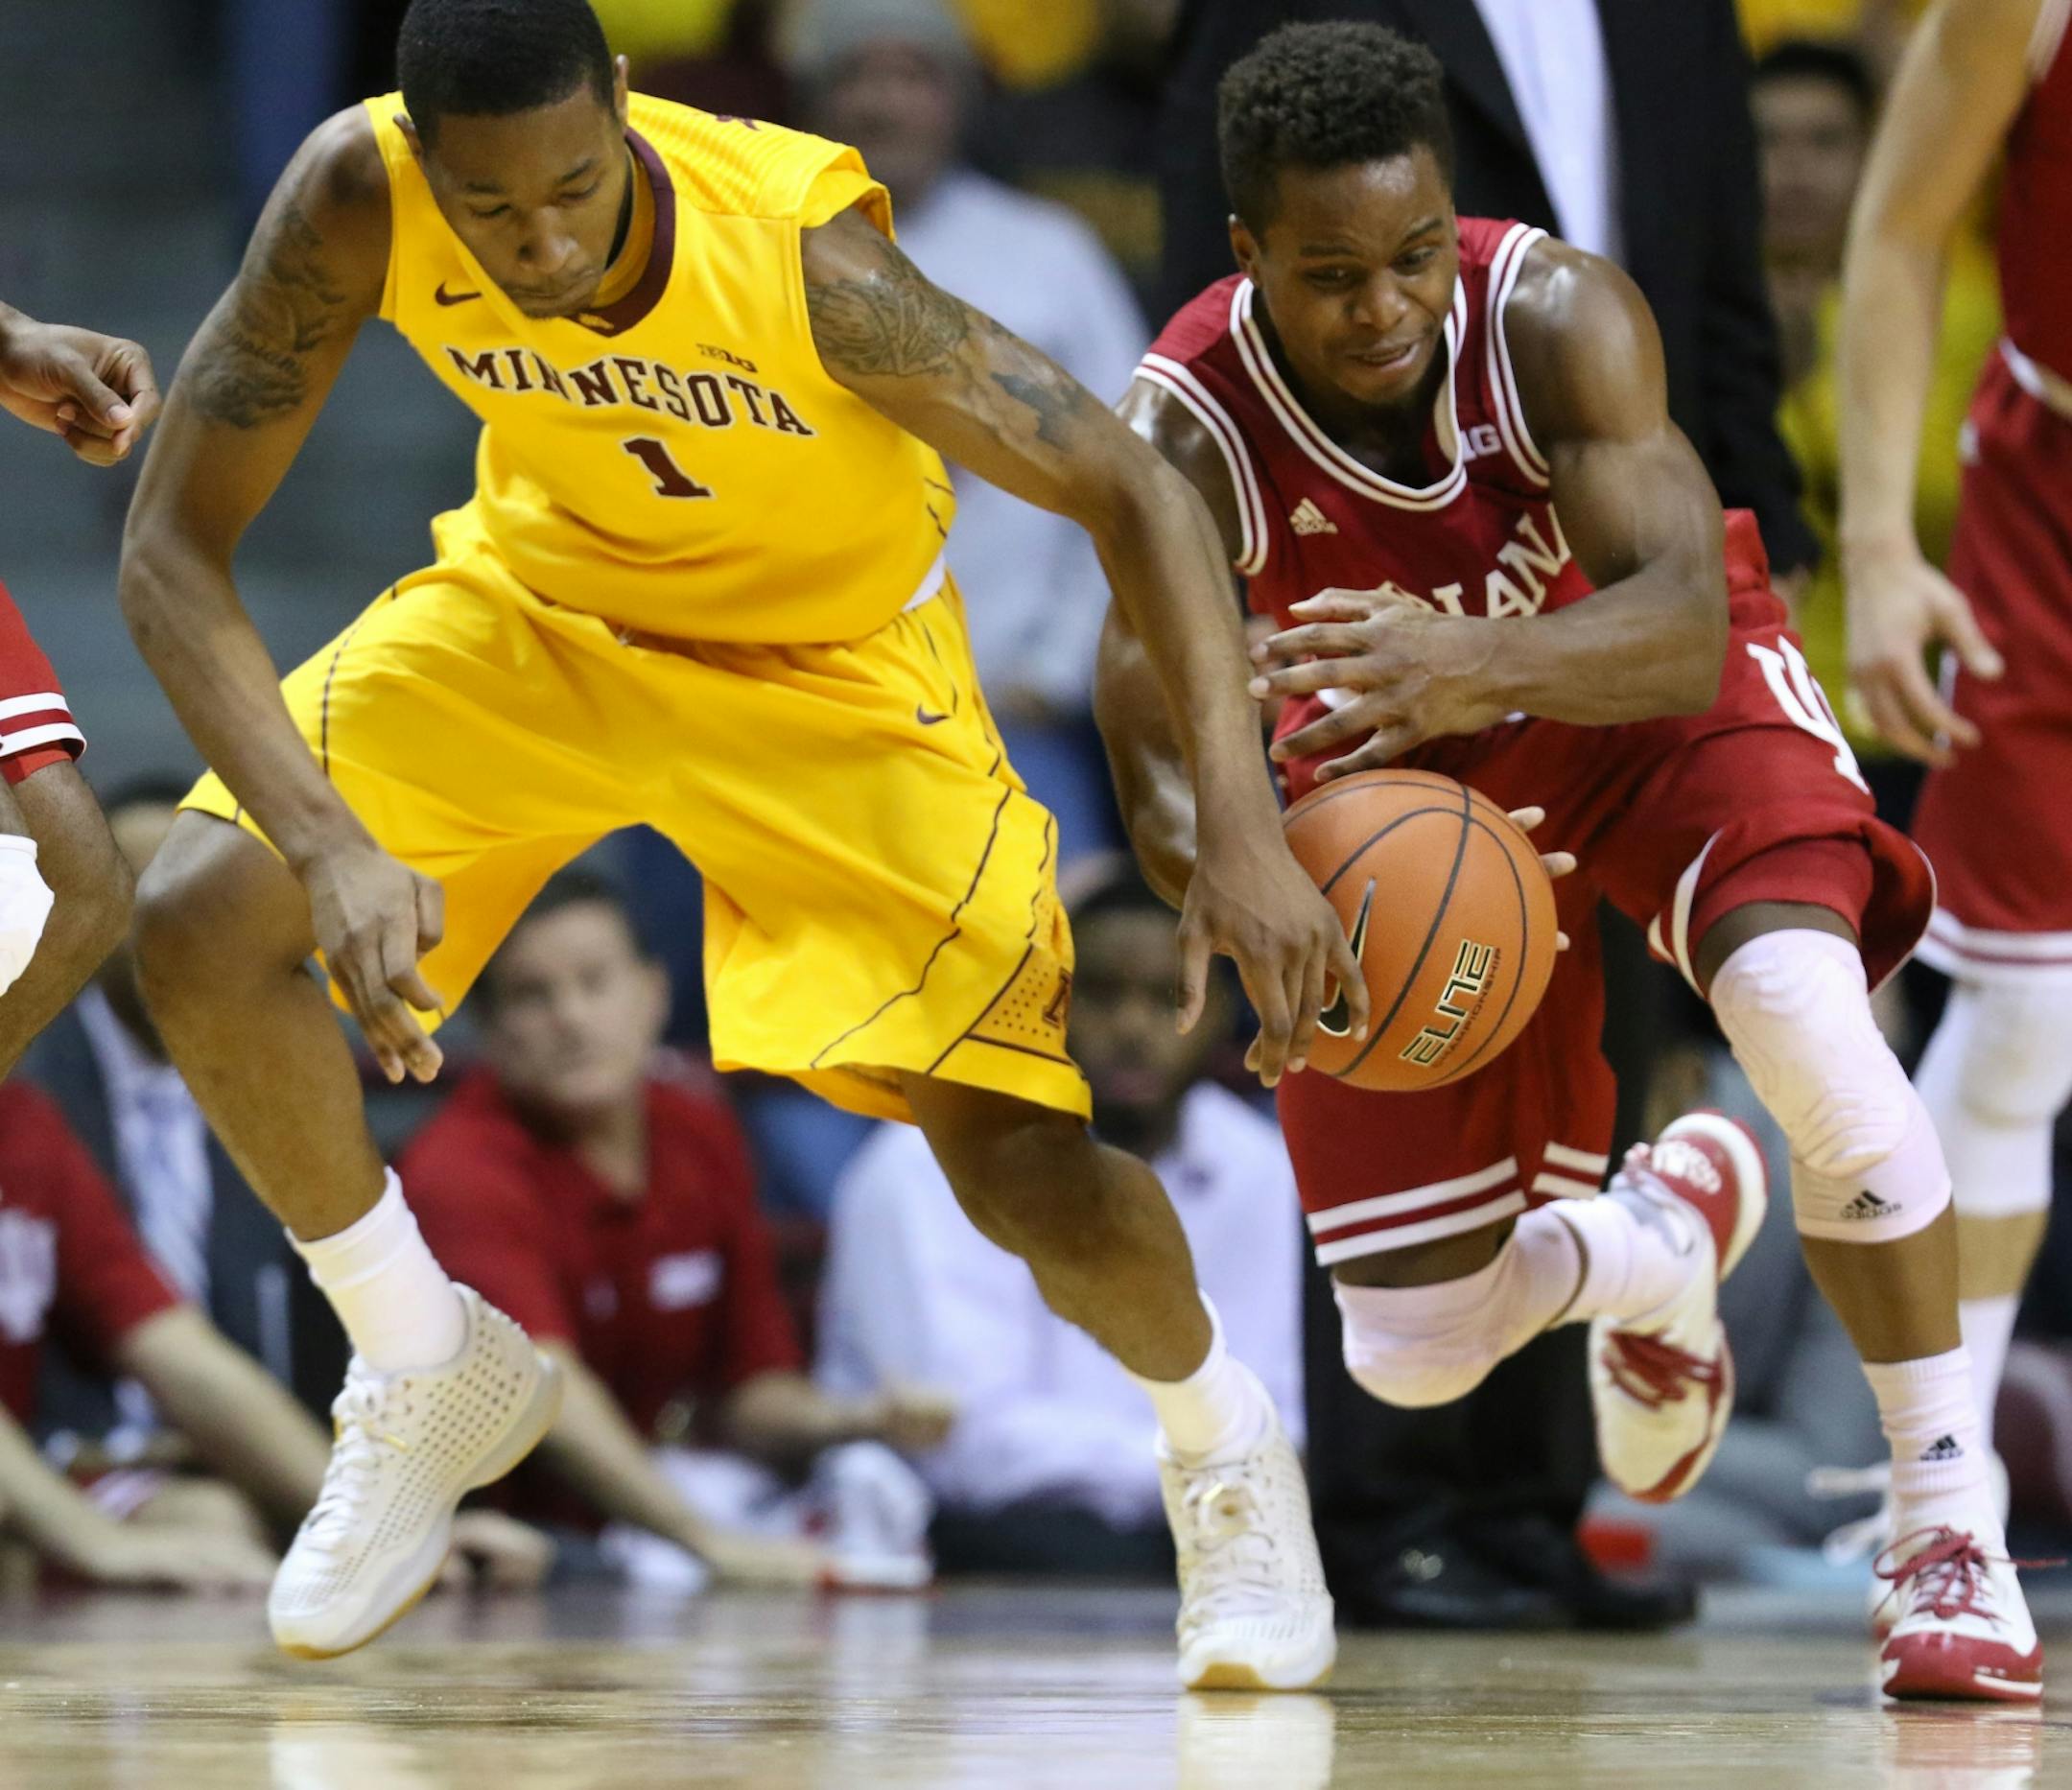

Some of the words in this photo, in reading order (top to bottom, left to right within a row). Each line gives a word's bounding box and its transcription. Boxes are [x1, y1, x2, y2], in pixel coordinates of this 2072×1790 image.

[443, 345, 816, 437] MINNESOTA
[623, 436, 714, 499] 1
[1399, 939, 1493, 1066] ELITE
